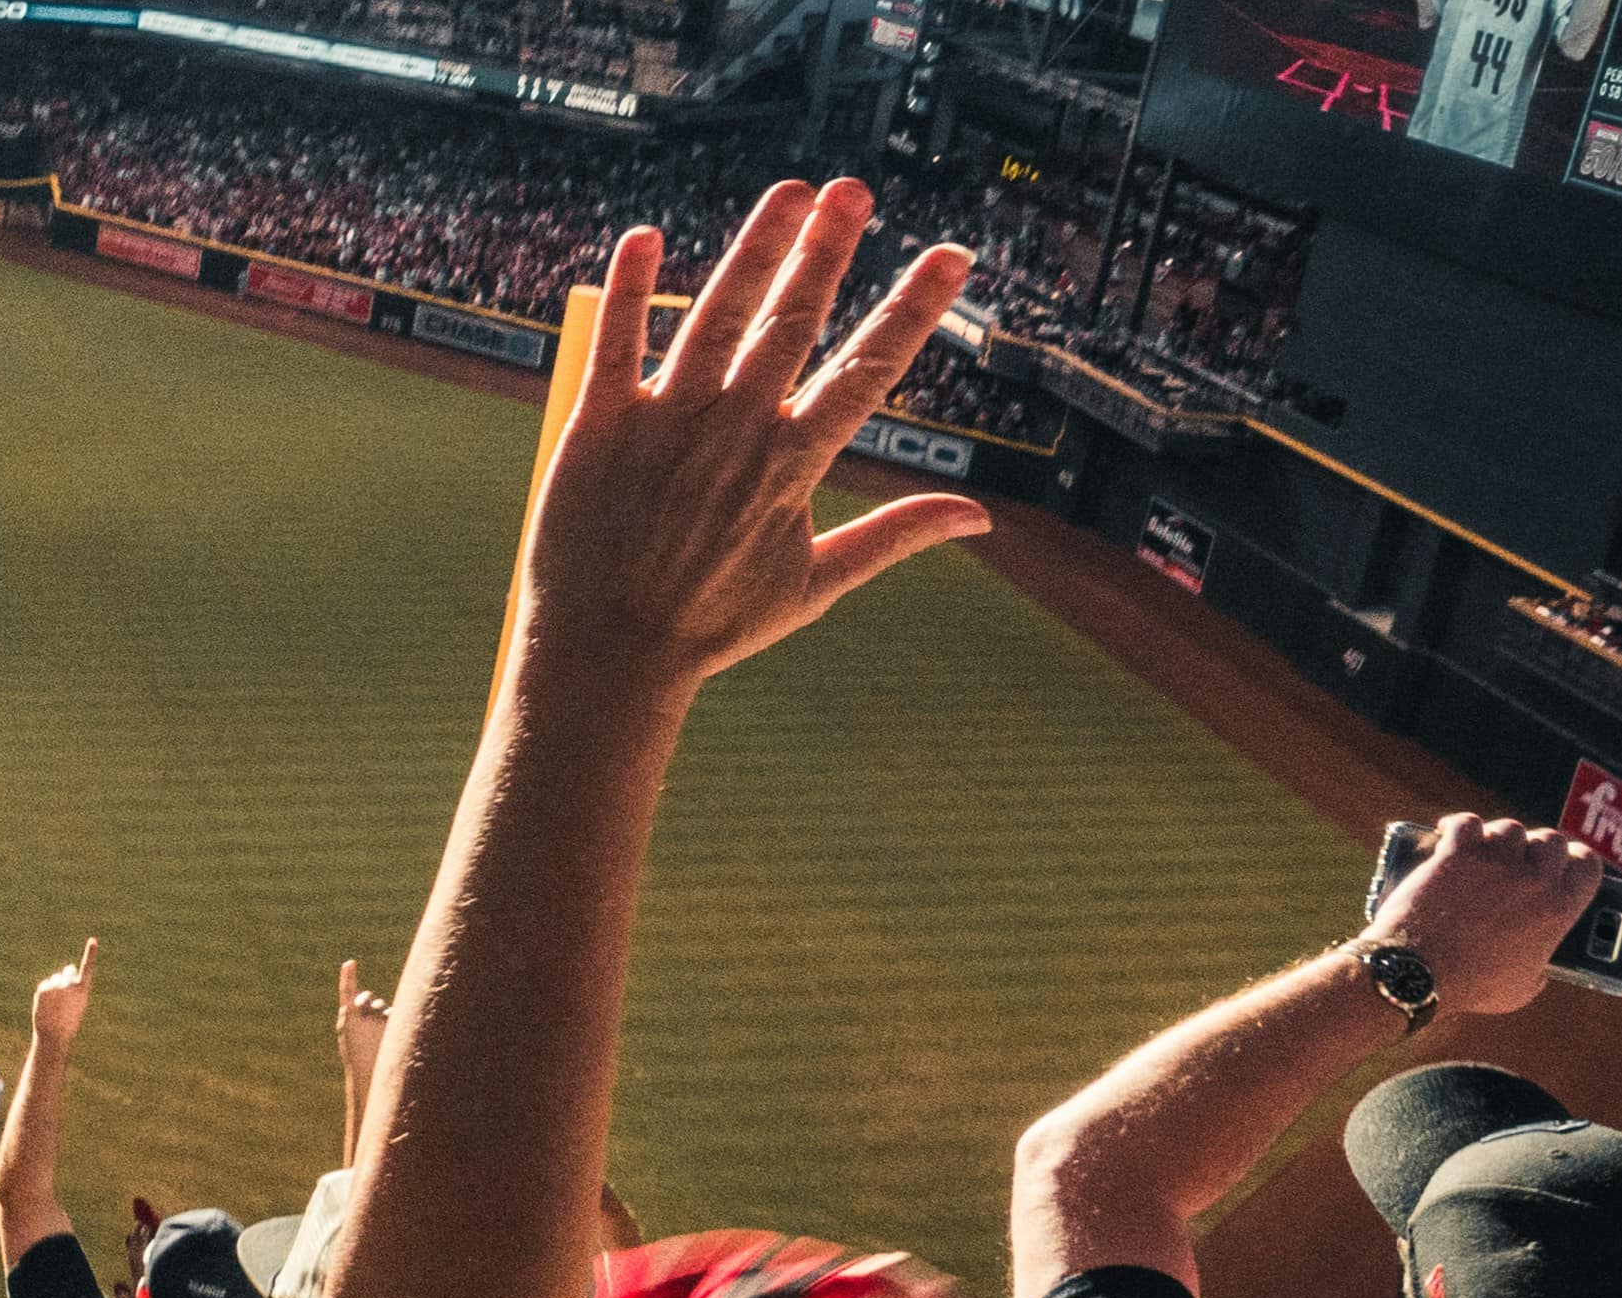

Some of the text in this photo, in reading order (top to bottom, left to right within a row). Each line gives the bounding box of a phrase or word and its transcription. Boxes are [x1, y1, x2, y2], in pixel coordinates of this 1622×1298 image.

[1470, 29, 1514, 96] 44
[426, 310, 507, 351] CHASE
[847, 417, 966, 474] EICO
